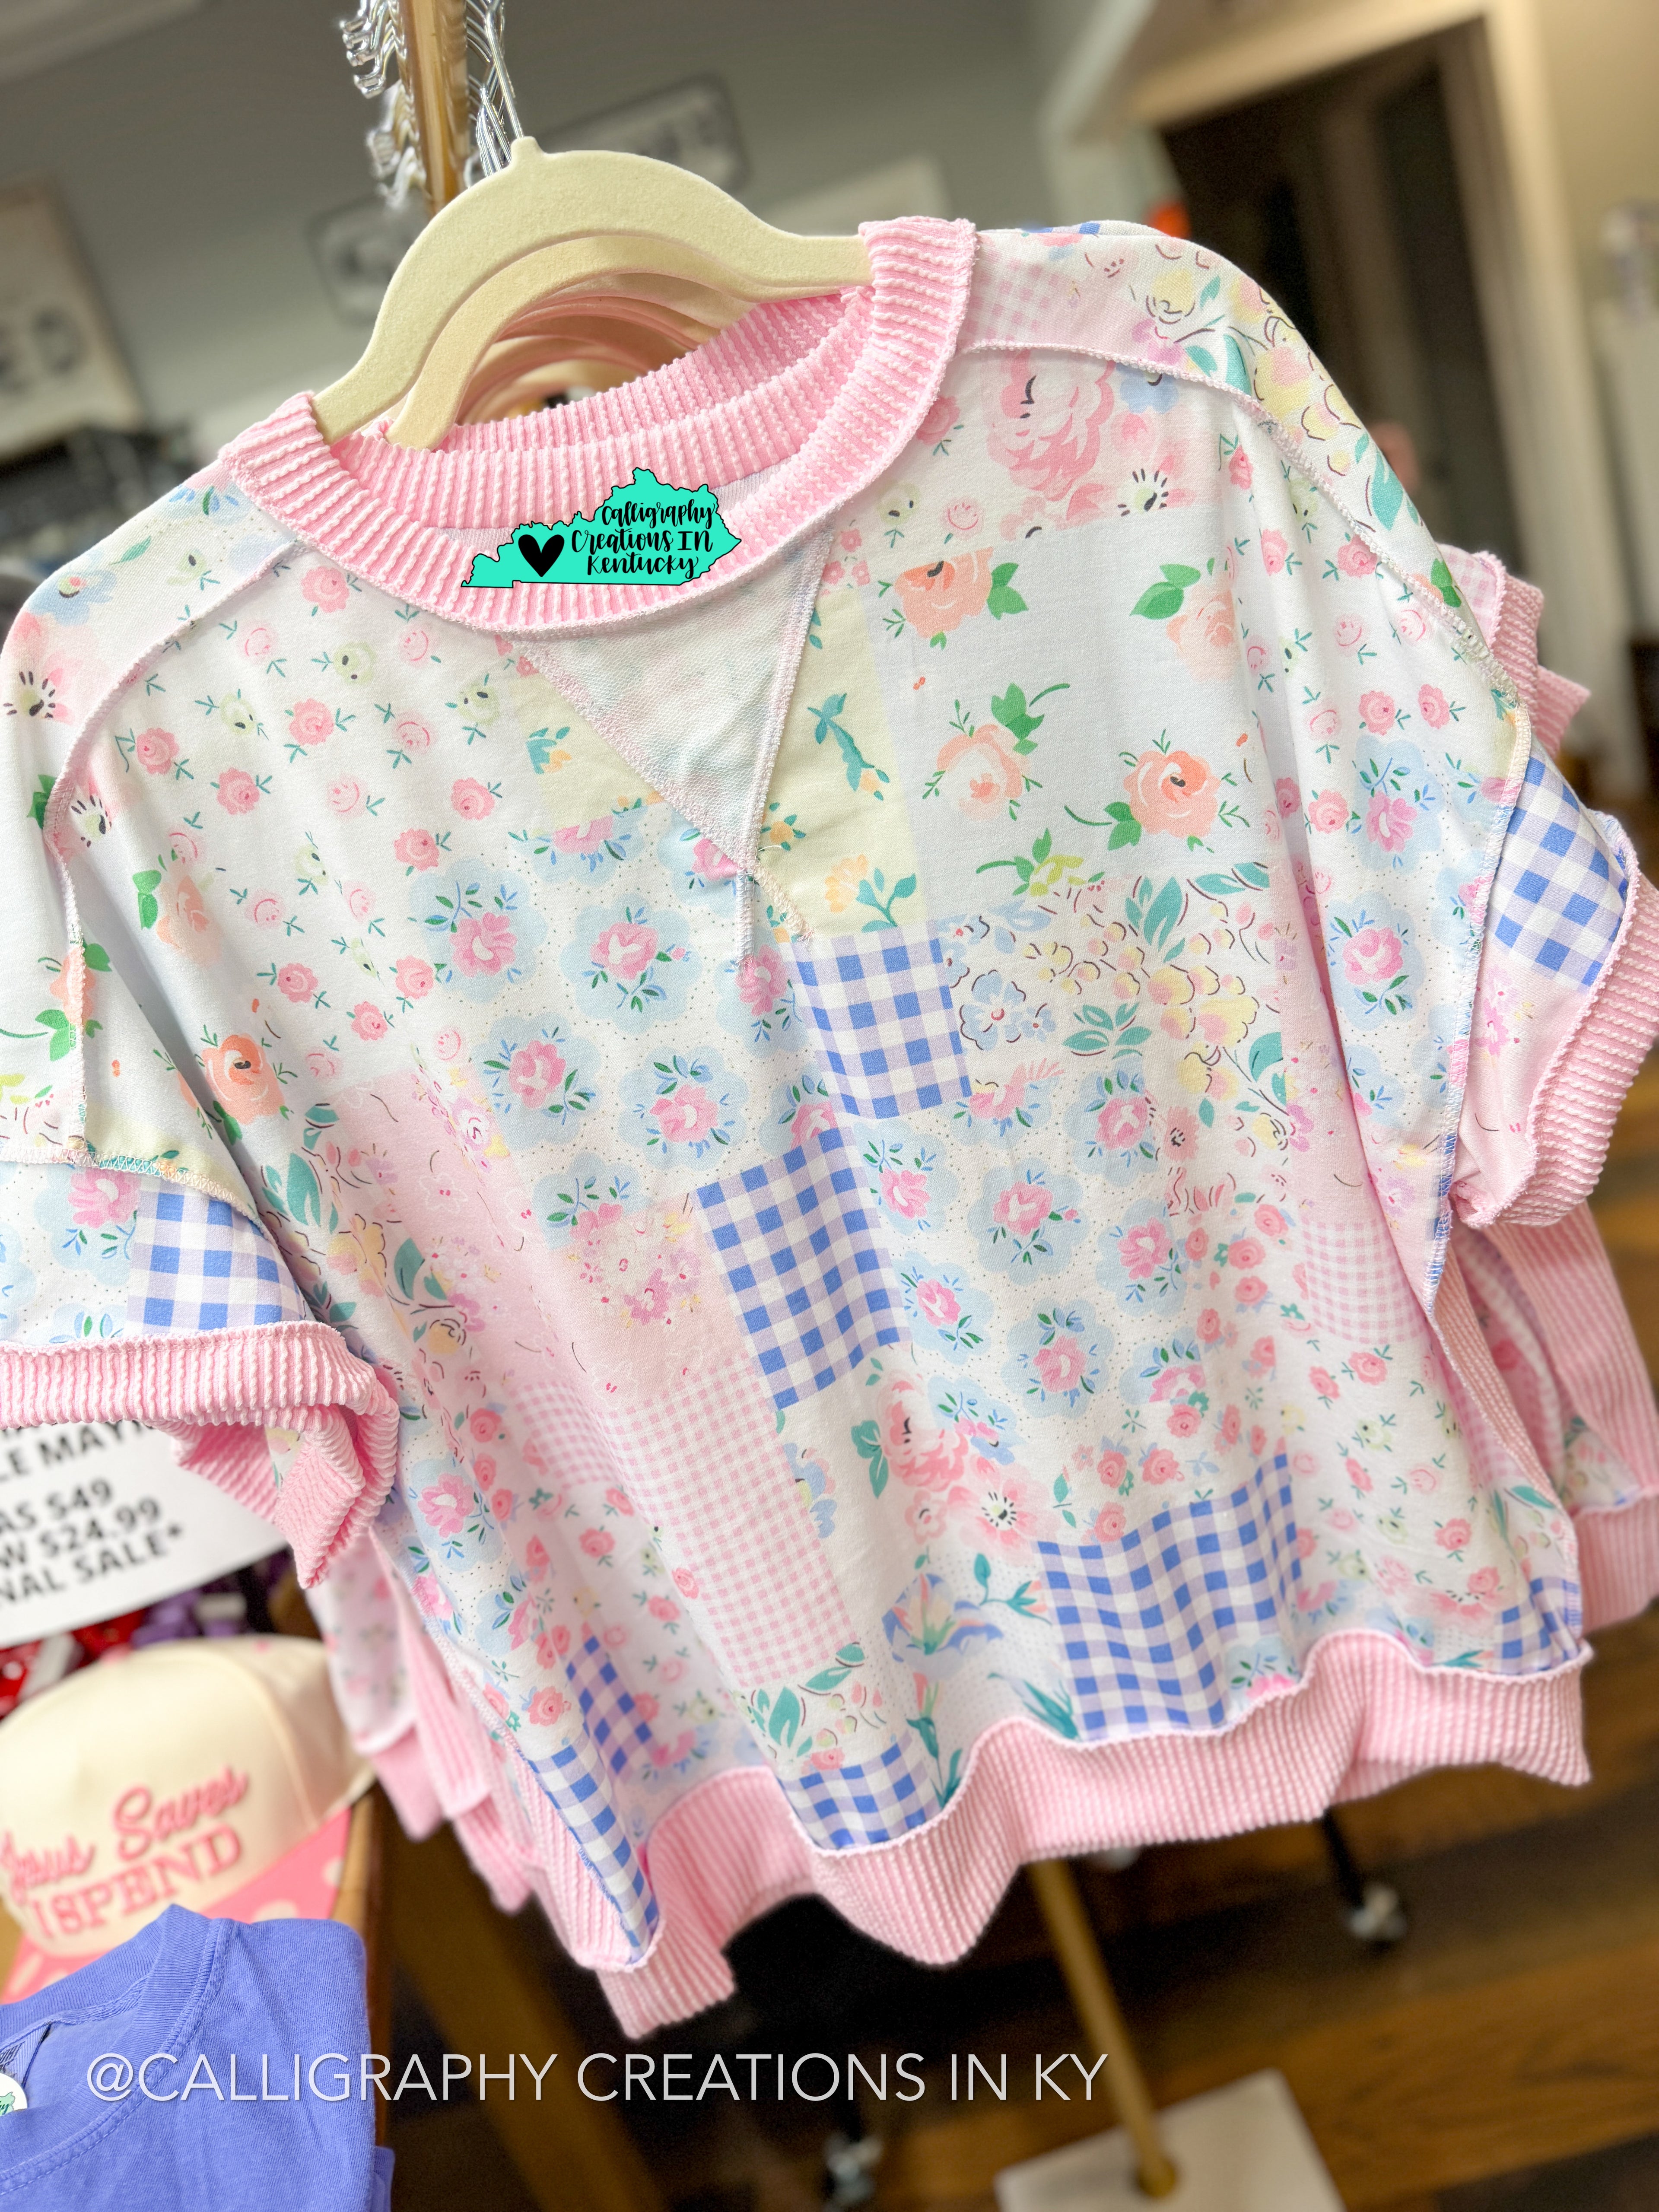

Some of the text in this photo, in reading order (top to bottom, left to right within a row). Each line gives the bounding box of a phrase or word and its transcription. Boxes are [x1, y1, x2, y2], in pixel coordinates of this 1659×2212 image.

[0, 1478, 112, 1535] AS $49
[39, 1496, 161, 1557] $24.99
[0, 1567, 67, 1601] NAL
